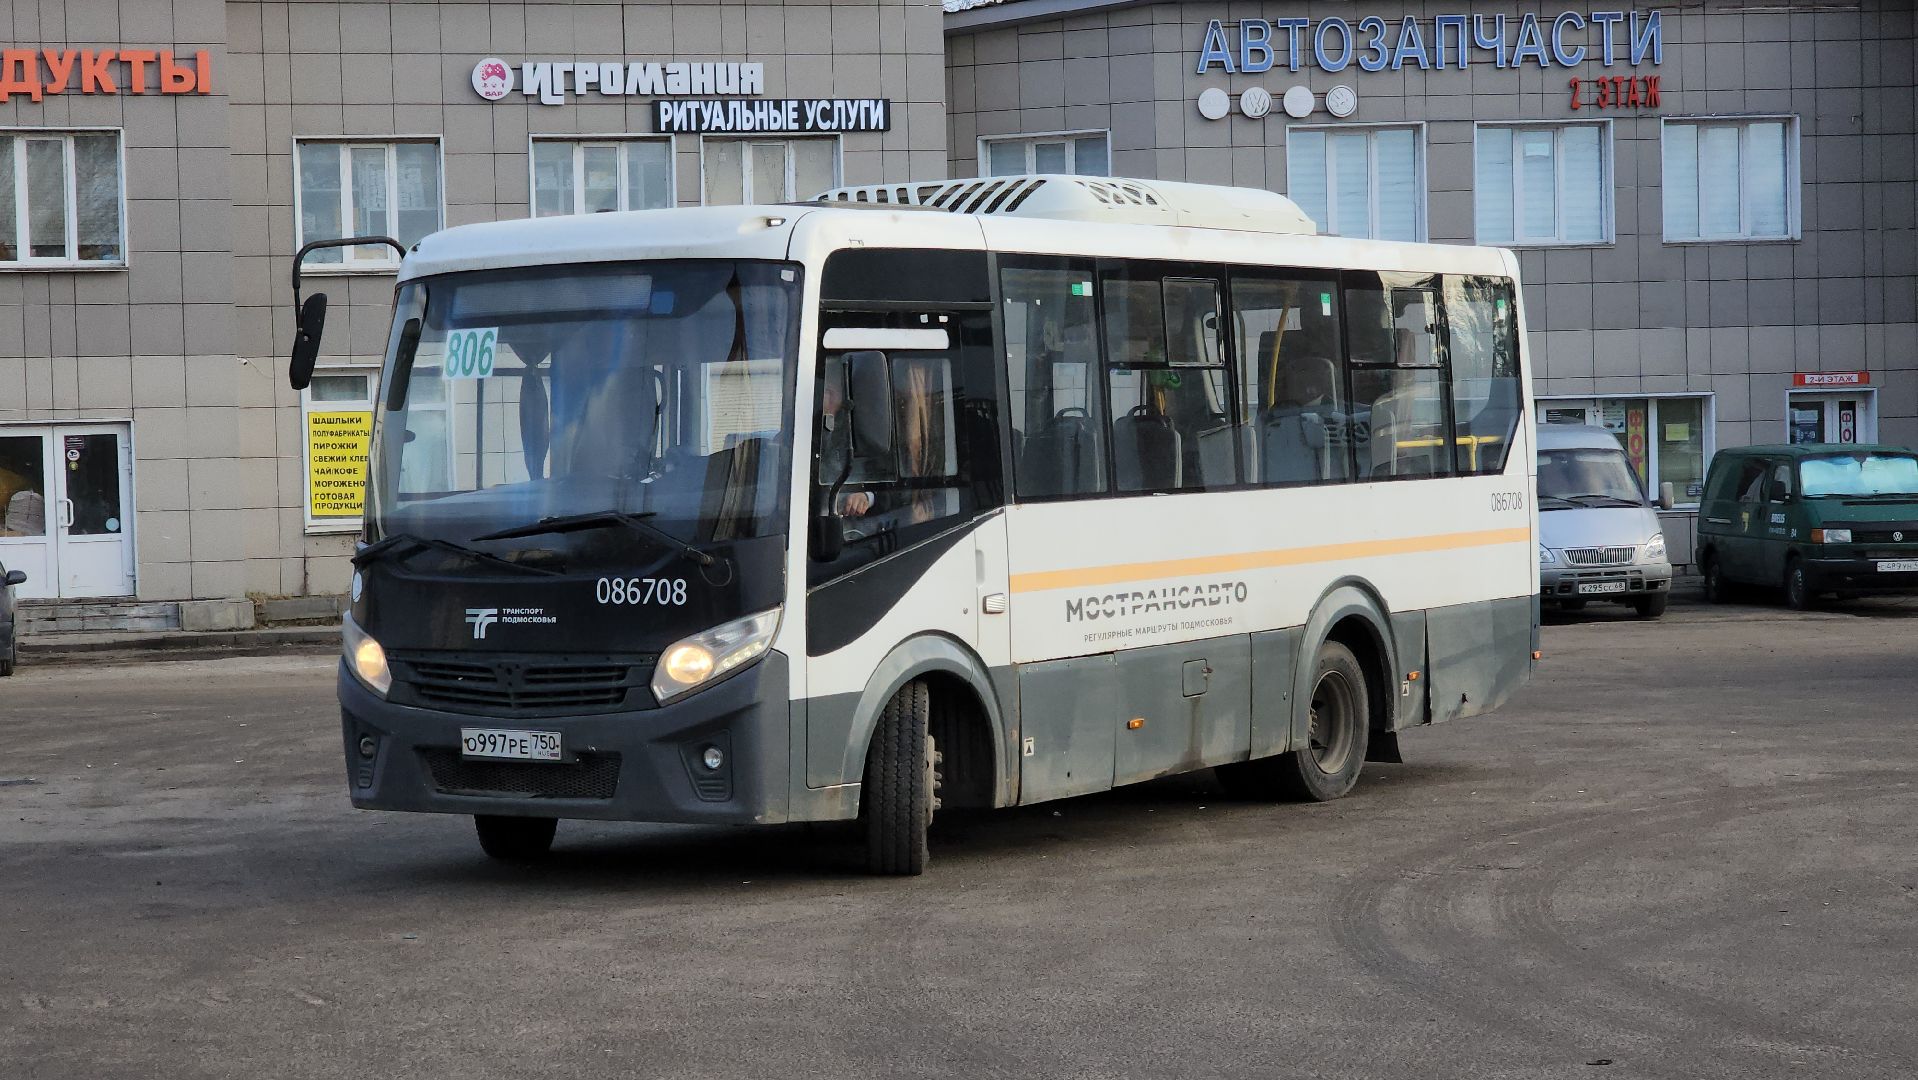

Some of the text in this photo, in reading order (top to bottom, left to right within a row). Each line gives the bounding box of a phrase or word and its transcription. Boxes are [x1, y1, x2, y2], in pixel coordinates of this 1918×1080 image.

[1197, 10, 1662, 74] АВТОЗАПЧАСТИ
[1571, 75, 1661, 109] 2 ЭТАЖ
[659, 99, 884, 132] РИТУАЛЬНЫЕ УСЛУГИ
[445, 330, 495, 377] 806
[1827, 375, 1853, 383] ЭТАЖ
[312, 417, 362, 425] ШАШЛЫКИ
[313, 455, 347, 463] СВЕЖИЙ
[314, 492, 355, 500] ГОТОВАЯ
[1491, 491, 1522, 511] 086708
[596, 577, 687, 605] 086708
[1065, 581, 1248, 623] МОСТРАНСАВТО
[502, 616, 556, 624] ПОДМОСКОВЬЯ
[1084, 616, 1233, 643] РЕГУЛЯРНЫЕ МАРШРУТЫ ПОДМОСКОВЬЯ
